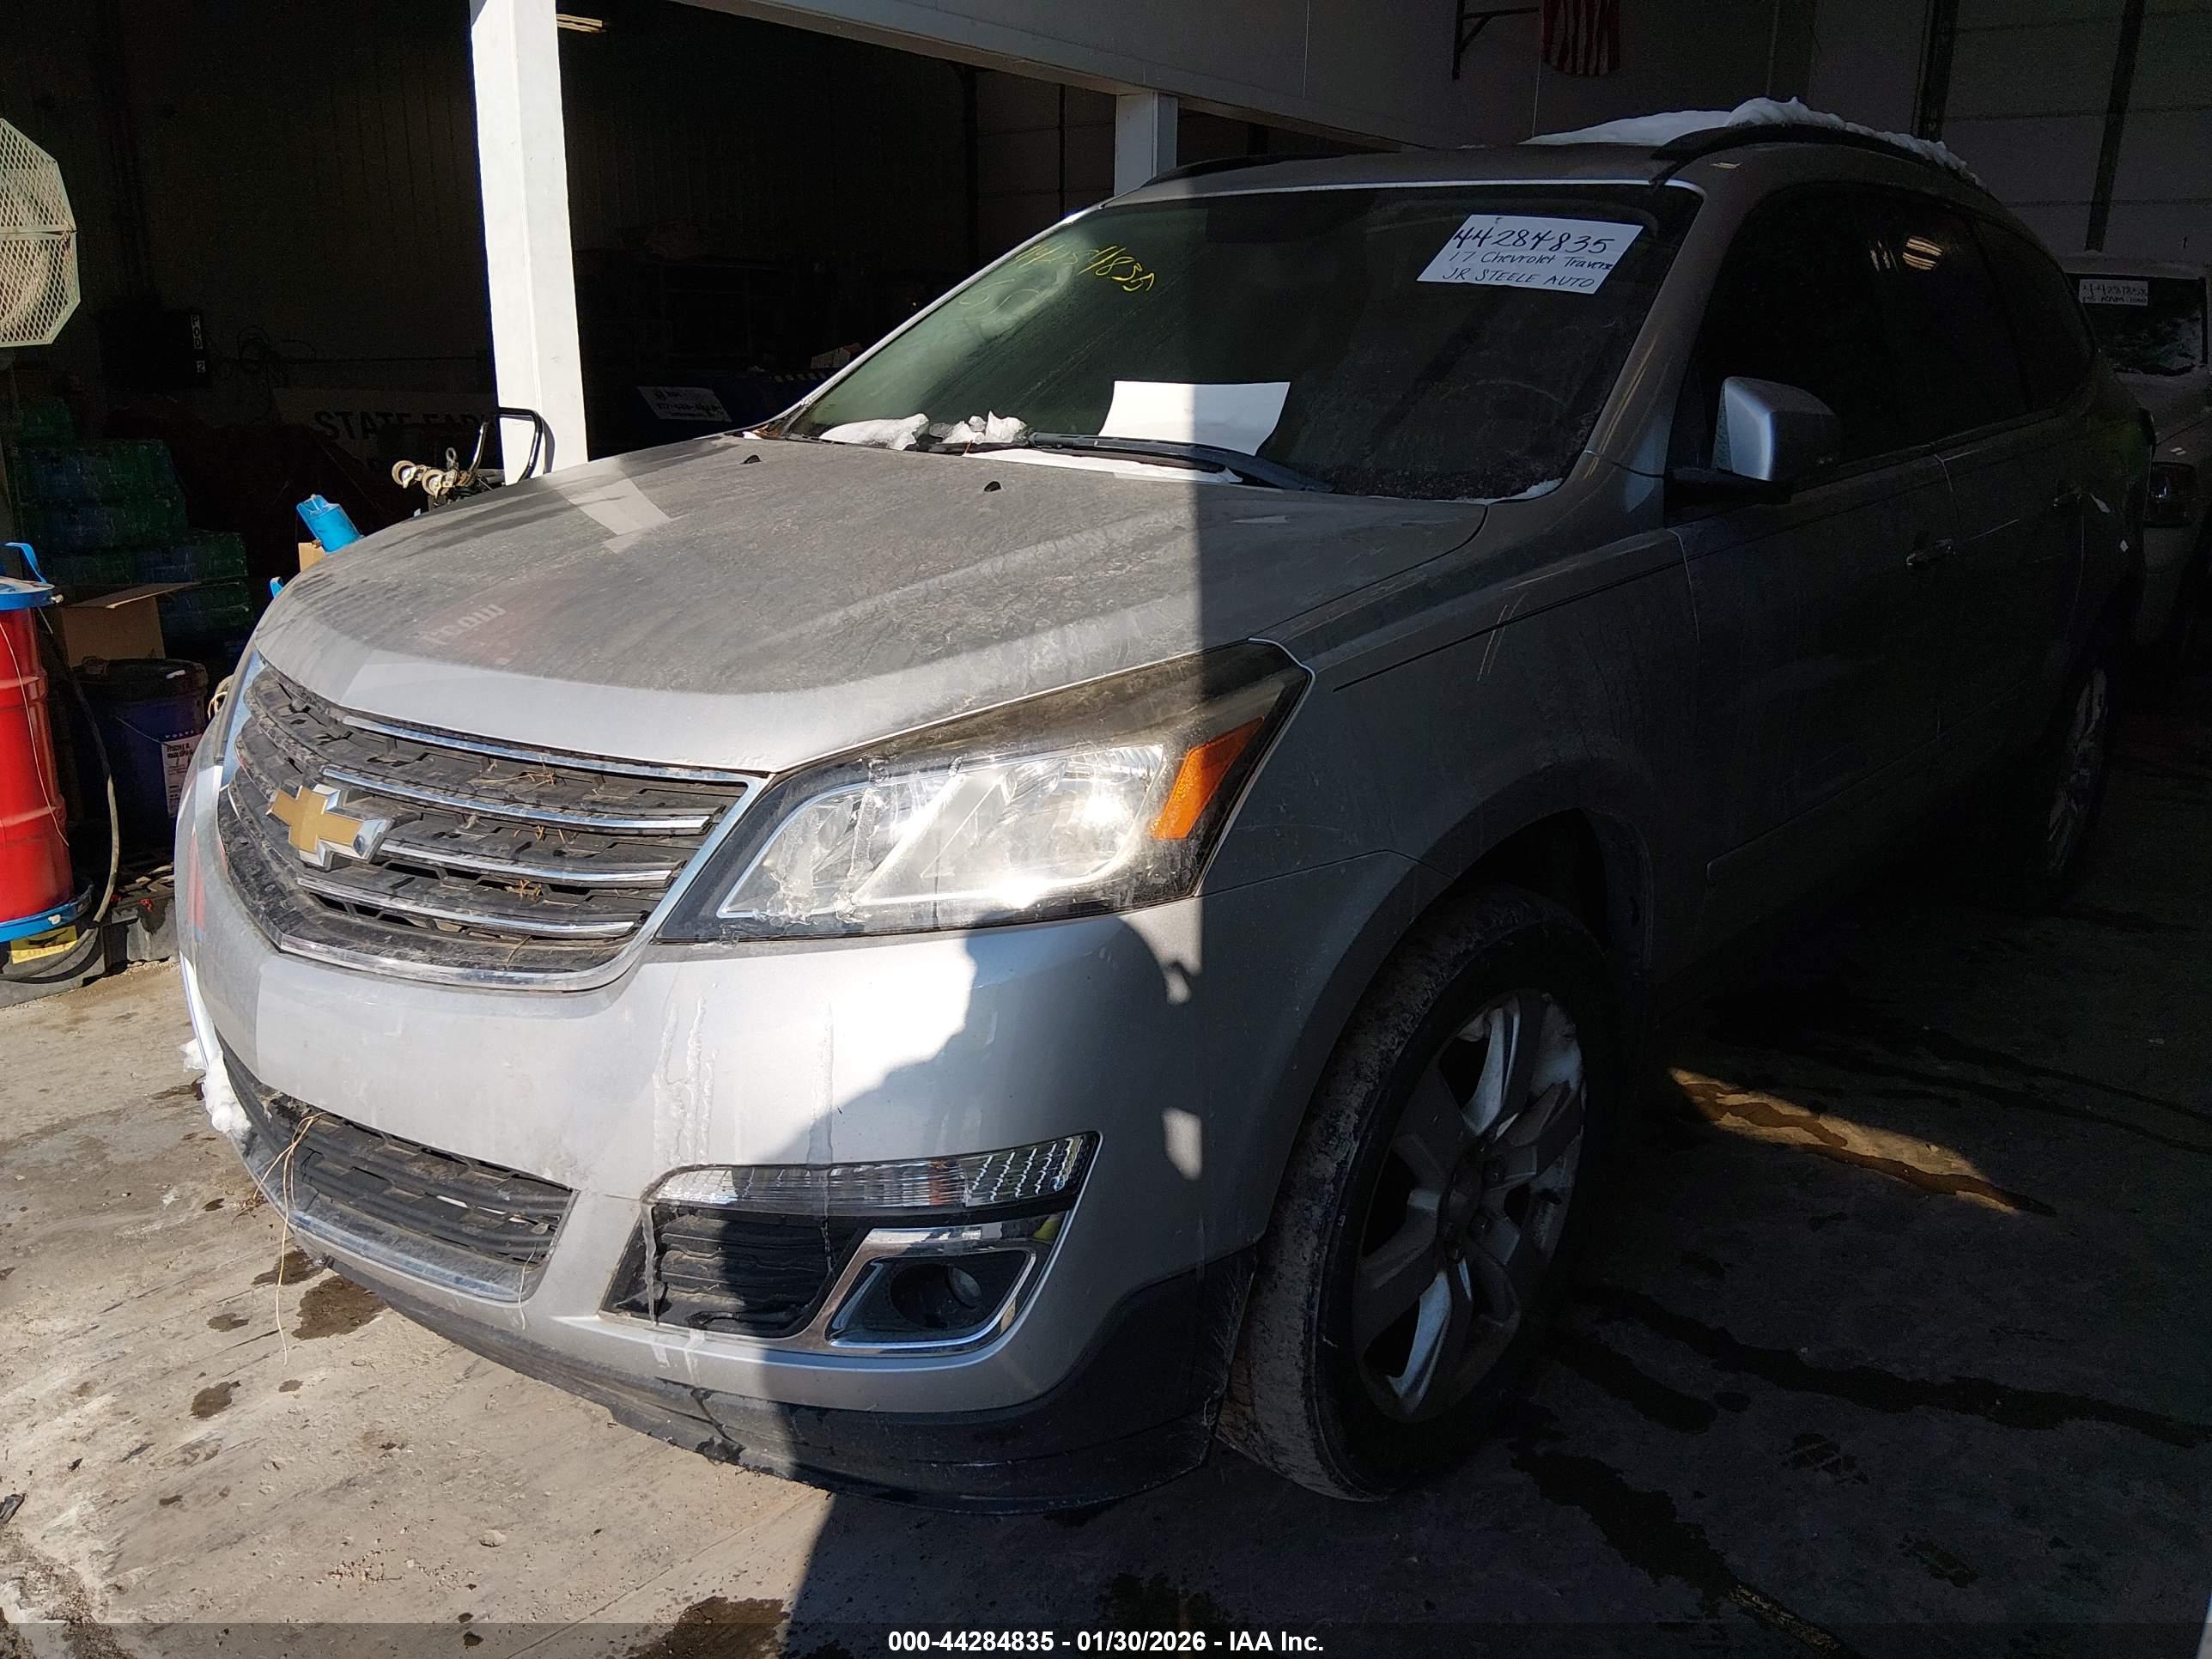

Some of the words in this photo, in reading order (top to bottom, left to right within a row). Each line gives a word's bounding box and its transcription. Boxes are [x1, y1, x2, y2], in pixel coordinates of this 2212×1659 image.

[1452, 226, 1615, 254] 44284835
[1449, 251, 1477, 263] 17
[1480, 251, 1557, 265] Chevrolet
[1442, 267, 1471, 281] JR
[1474, 268, 1541, 283] STEELE
[1542, 274, 1595, 289] AUTO
[198, 362, 204, 372] 2
